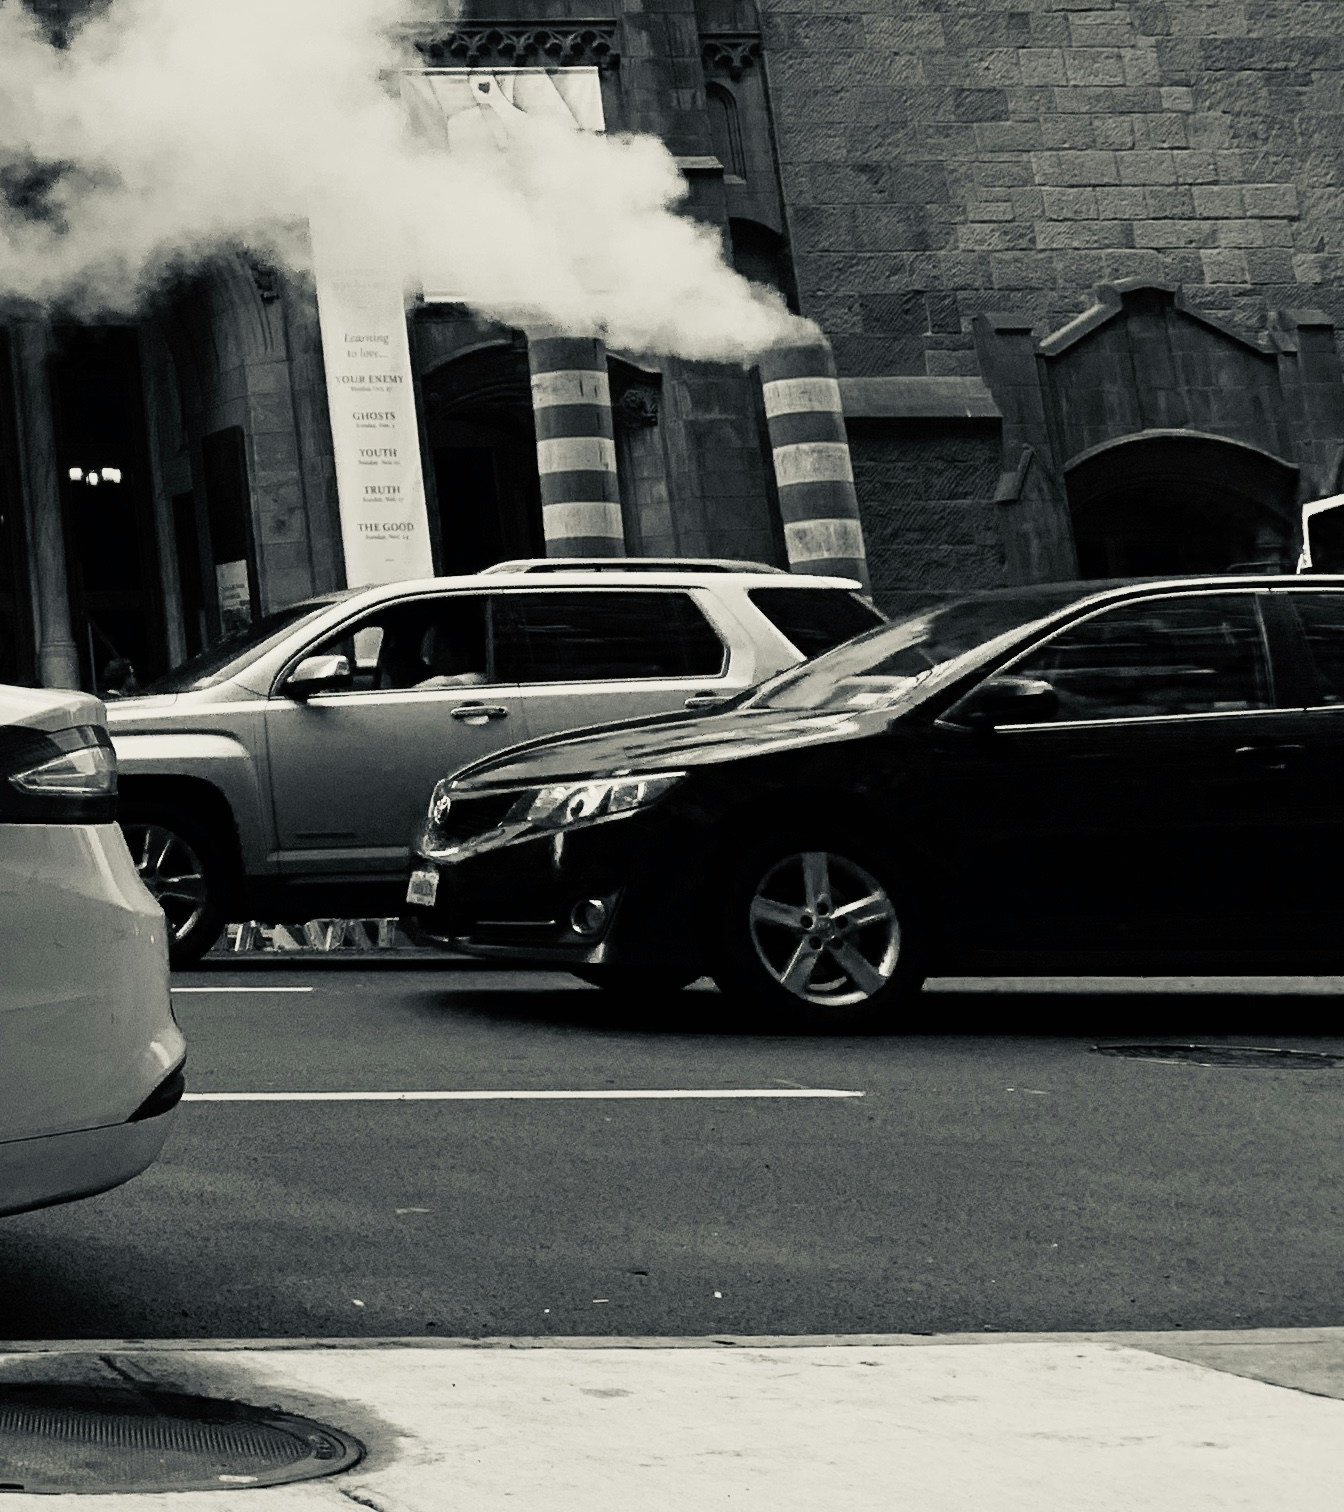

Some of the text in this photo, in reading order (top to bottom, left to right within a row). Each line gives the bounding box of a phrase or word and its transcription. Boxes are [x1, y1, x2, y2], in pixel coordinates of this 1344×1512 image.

[344, 333, 389, 345] Learning
[347, 350, 357, 358] to
[335, 375, 404, 384] YOUR ENEMY
[353, 411, 396, 421] GHOSTS
[359, 448, 398, 458] YOUTH
[364, 485, 401, 495] TRUTH
[357, 522, 414, 532] THE GOOD
